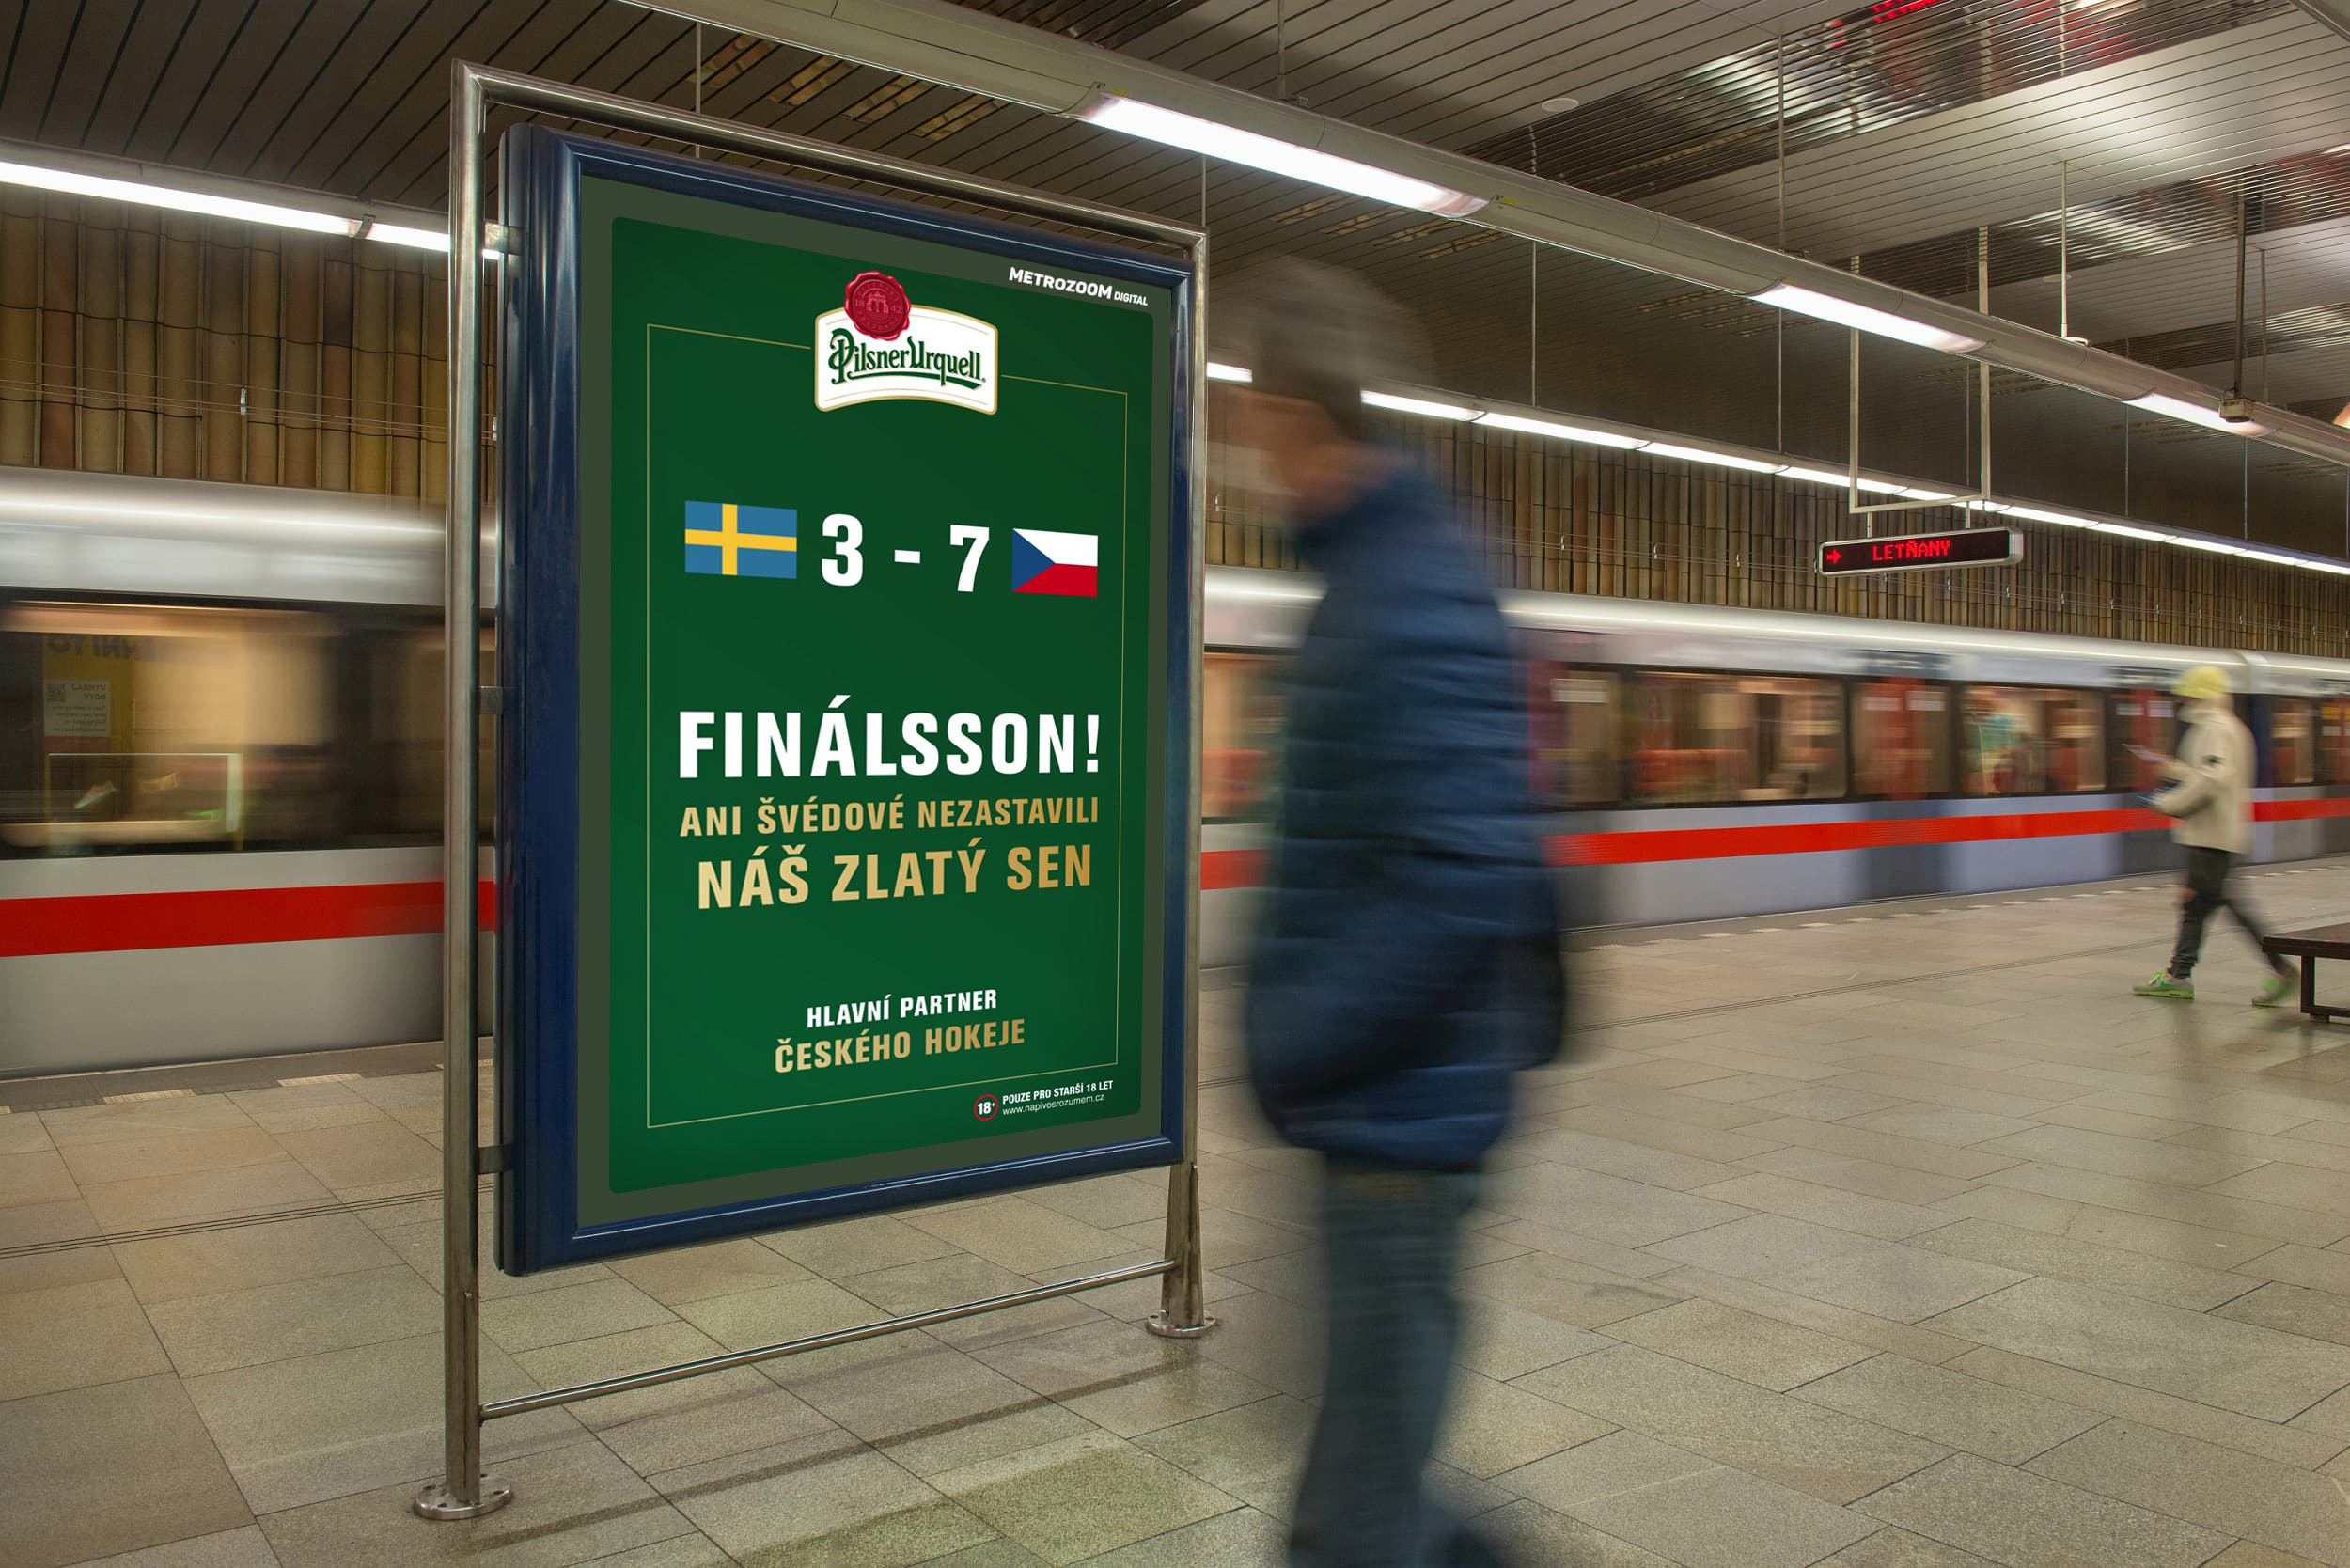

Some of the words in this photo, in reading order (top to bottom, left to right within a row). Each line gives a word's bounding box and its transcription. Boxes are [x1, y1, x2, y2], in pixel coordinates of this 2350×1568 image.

[1009, 267, 1113, 299] METROZOOM
[1114, 291, 1148, 306] DIGITAL
[854, 298, 865, 308] 18
[890, 305, 902, 315] 42
[828, 327, 910, 385] Pilsner
[907, 336, 981, 386] Urquell
[822, 513, 863, 587] 3
[950, 524, 990, 592] 7
[1872, 540, 1951, 561] LETŇANY
[680, 694, 1100, 778] FINÁLSSON!
[680, 806, 741, 837] ANI
[757, 794, 904, 835] ŠVÉDOVÉ
[918, 796, 1098, 828] NEZASTAVILI
[698, 844, 809, 909] NÁŠ
[832, 838, 986, 902] ZLATÝ
[1007, 844, 1090, 890] SEN
[807, 994, 891, 1027] HLAVNÍ
[900, 989, 997, 1018] PARTNER
[775, 1028, 911, 1074] ČESKÉHO
[925, 1018, 1026, 1056] HOKEJE
[977, 1101, 995, 1115] 18+
[1002, 1091, 1031, 1105] POUZE
[1033, 1089, 1052, 1101] PRO
[1053, 1082, 1084, 1097] STARŠÍ
[1086, 1082, 1097, 1092] 18
[1098, 1080, 1114, 1090] LET
[1002, 1093, 1104, 1116] www.napivosrozumem.cz
